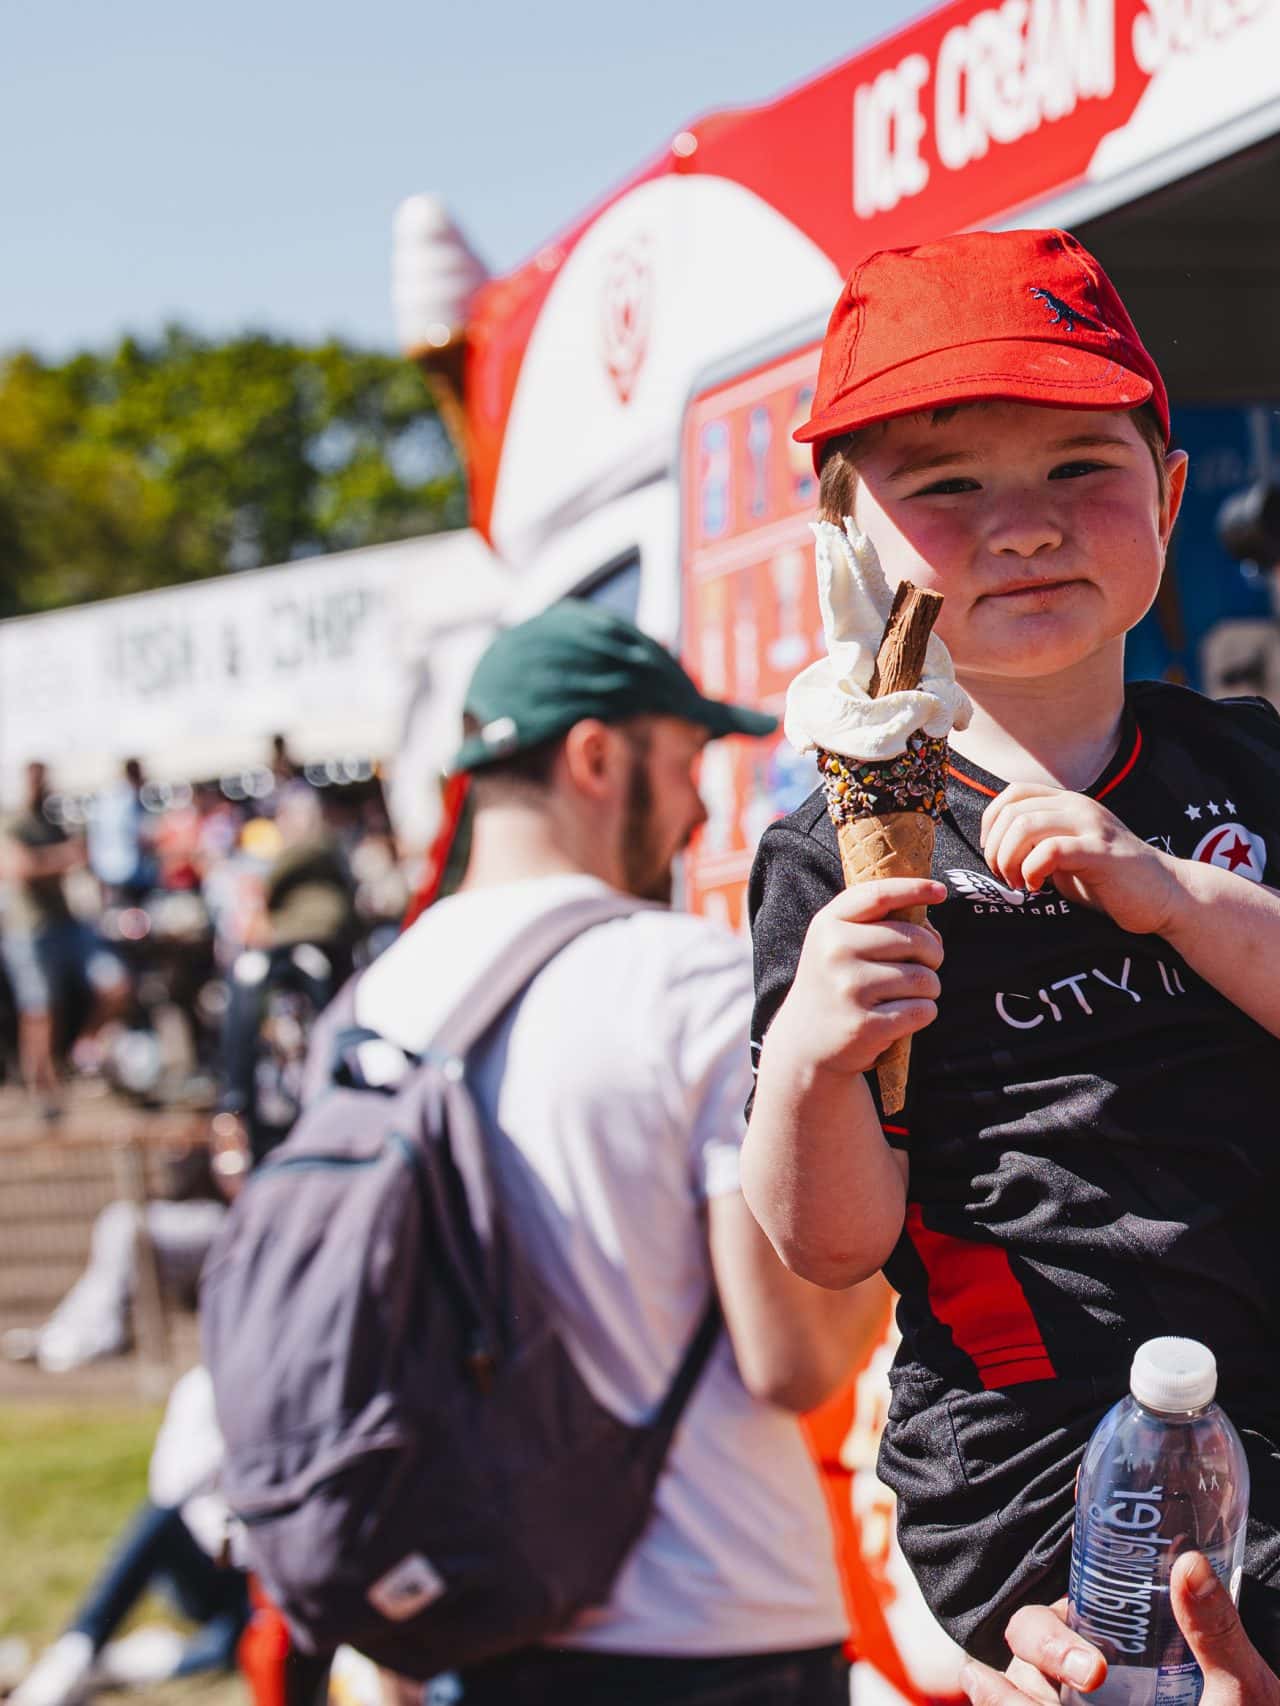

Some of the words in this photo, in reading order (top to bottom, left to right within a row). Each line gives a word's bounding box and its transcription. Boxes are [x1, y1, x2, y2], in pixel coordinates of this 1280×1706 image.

[853, 53, 930, 219] ICE
[936, 0, 1115, 170] CREAM
[995, 957, 1142, 1029] CITY
